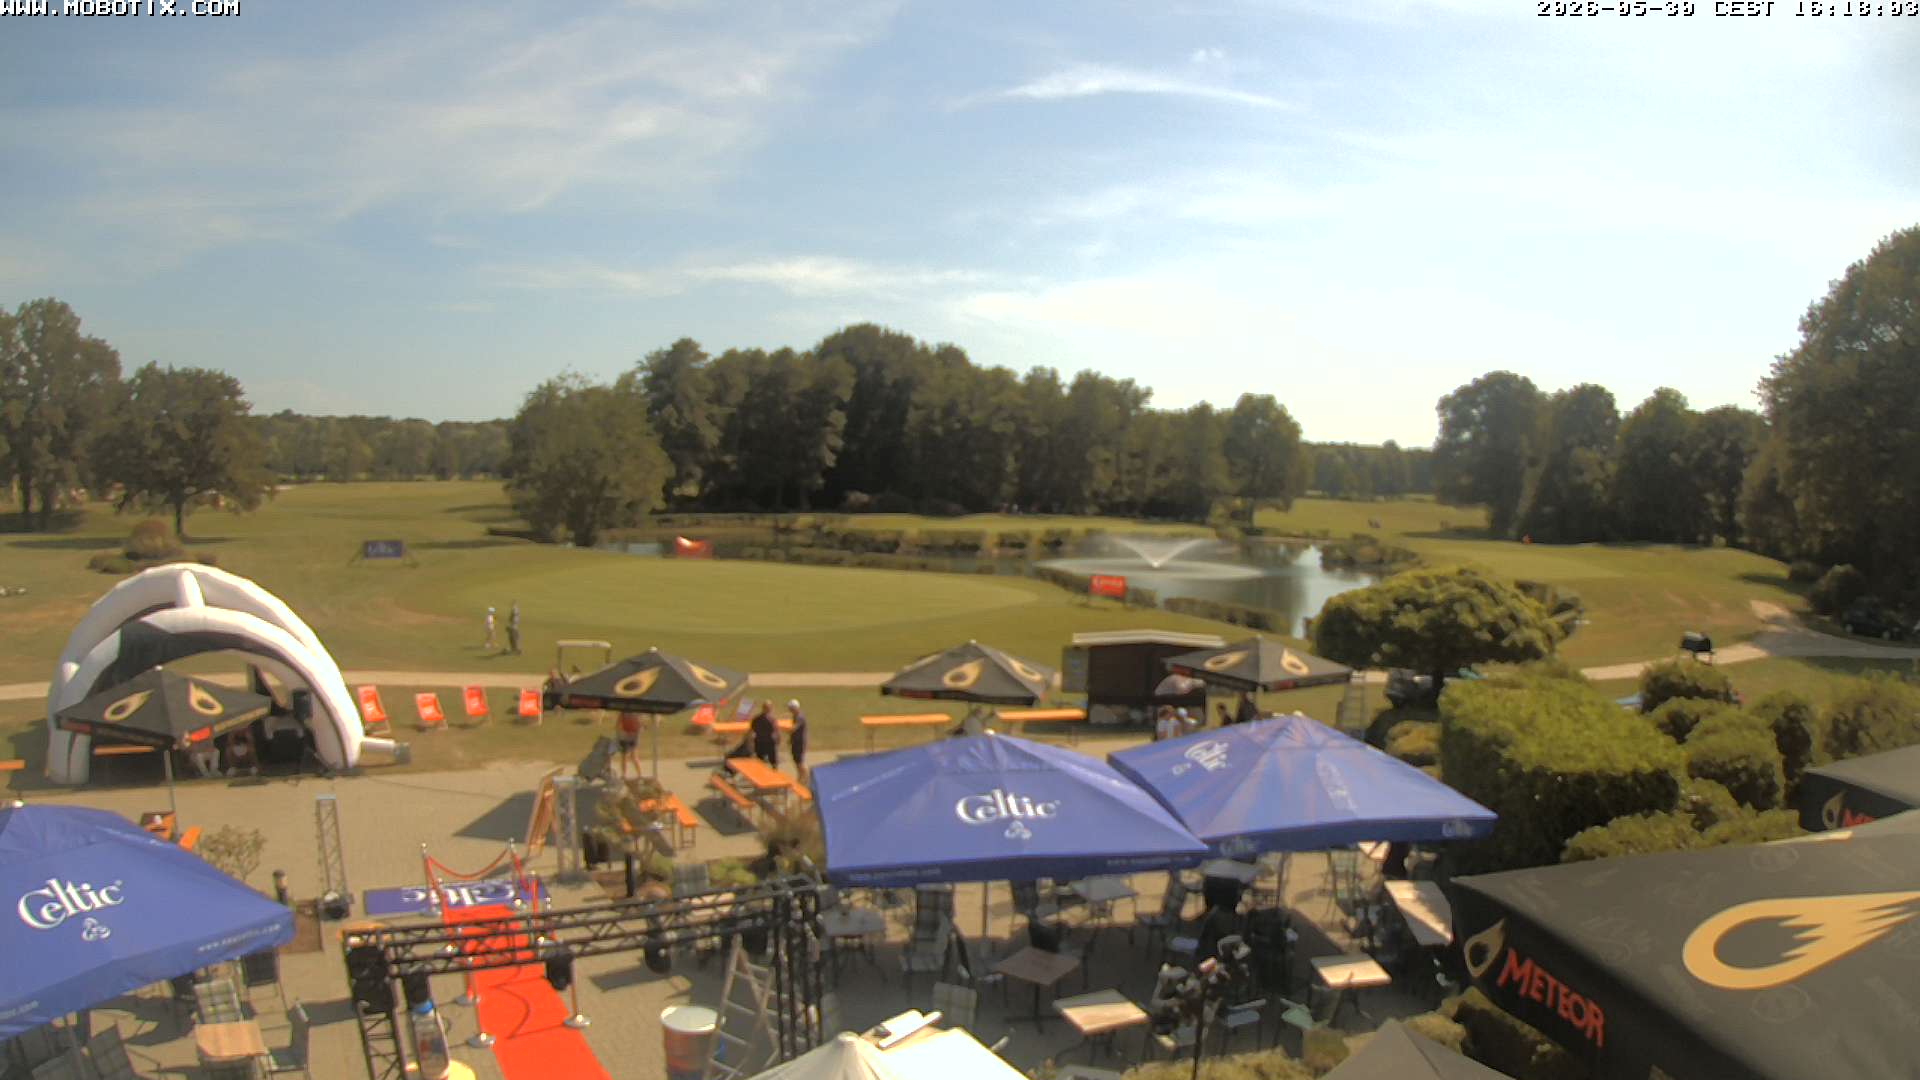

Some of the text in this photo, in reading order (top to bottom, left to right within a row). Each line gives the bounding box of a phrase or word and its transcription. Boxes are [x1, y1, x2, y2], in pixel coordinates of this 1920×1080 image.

[955, 788, 1058, 823] Celtic
[17, 878, 124, 929] Celtic
[1497, 947, 1606, 1049] METEOR
